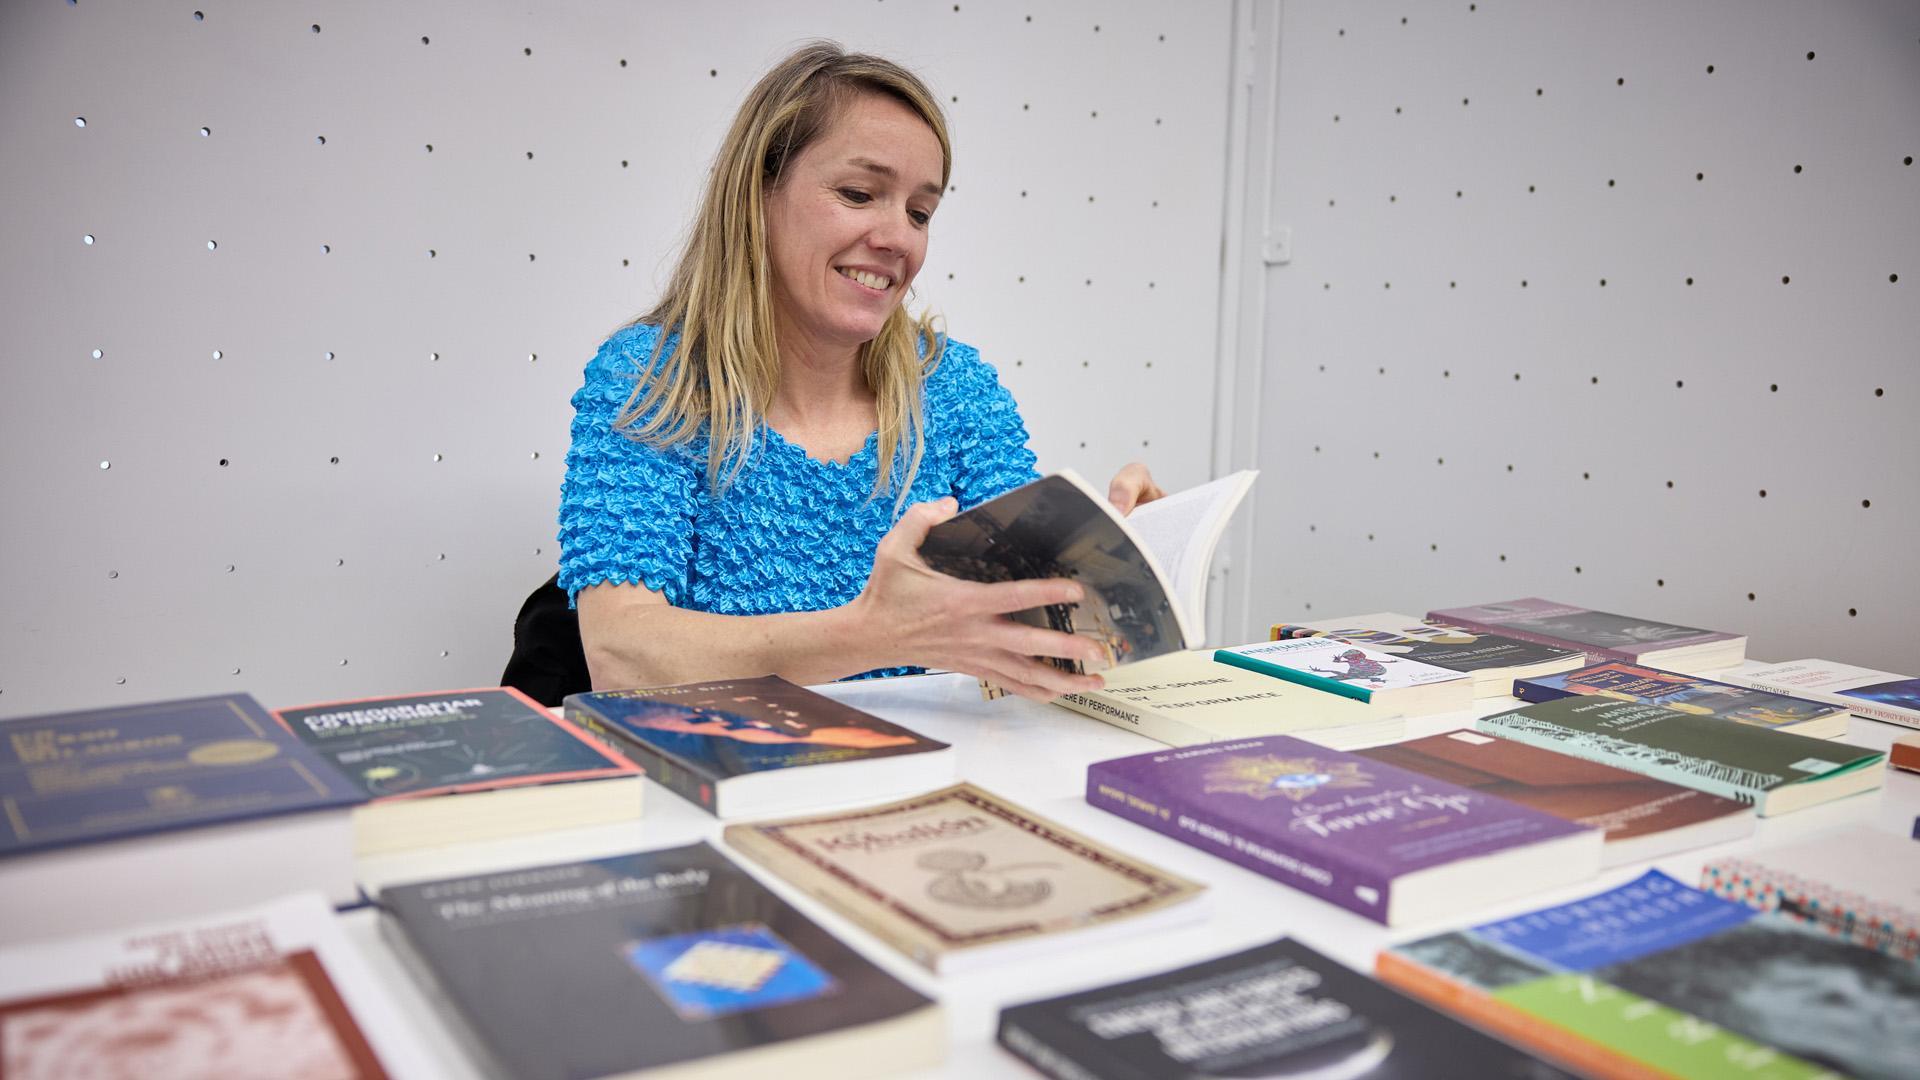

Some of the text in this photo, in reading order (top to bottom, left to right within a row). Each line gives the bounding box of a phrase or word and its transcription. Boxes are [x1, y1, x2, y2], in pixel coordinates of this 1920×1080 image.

[1104, 677, 1233, 695] PUBLIC SPHERE
[1078, 695, 1088, 707] BY
[1088, 699, 1140, 725] PERFORMANCE
[1150, 691, 1283, 710] PERFORMANCE
